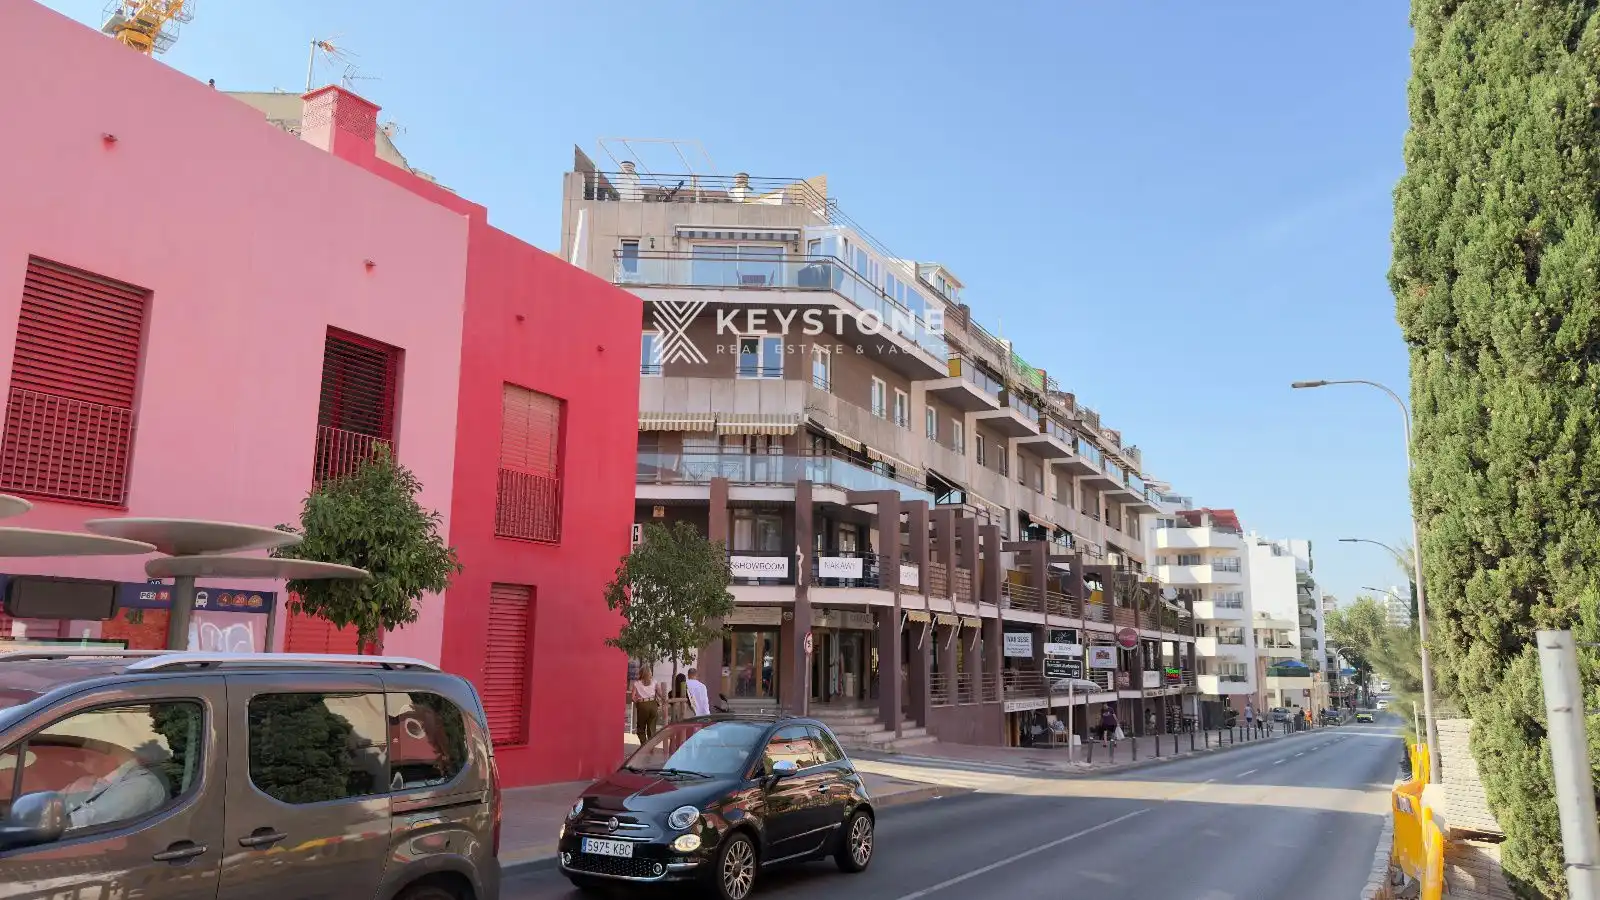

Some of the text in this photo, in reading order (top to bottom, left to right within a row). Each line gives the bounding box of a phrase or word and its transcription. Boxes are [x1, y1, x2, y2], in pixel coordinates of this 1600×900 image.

[734, 561, 785, 571] SHOWROOM
[588, 840, 631, 856] 5975 KBC
